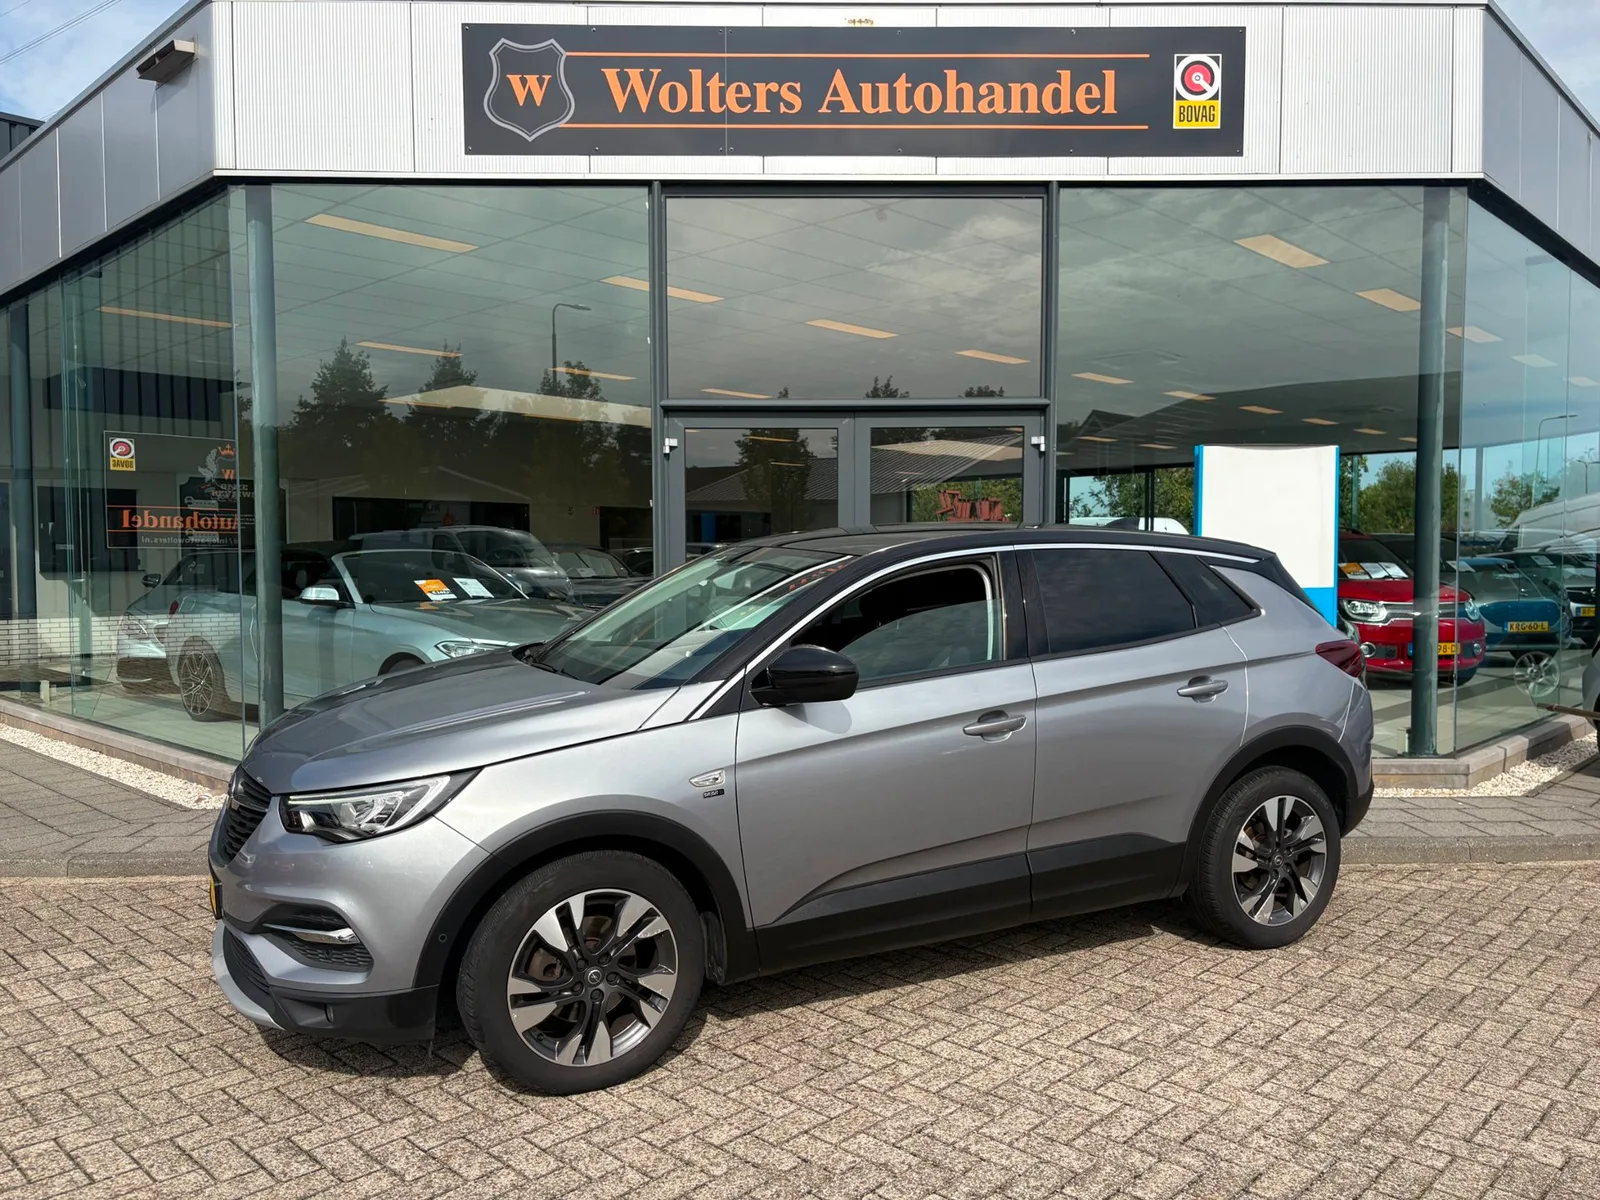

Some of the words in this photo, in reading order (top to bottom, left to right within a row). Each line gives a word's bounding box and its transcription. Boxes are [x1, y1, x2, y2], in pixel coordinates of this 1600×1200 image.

[506, 74, 552, 106] W
[601, 68, 803, 114] Wolters
[818, 67, 1118, 115] Autohandel
[1178, 104, 1216, 123] BOVAG
